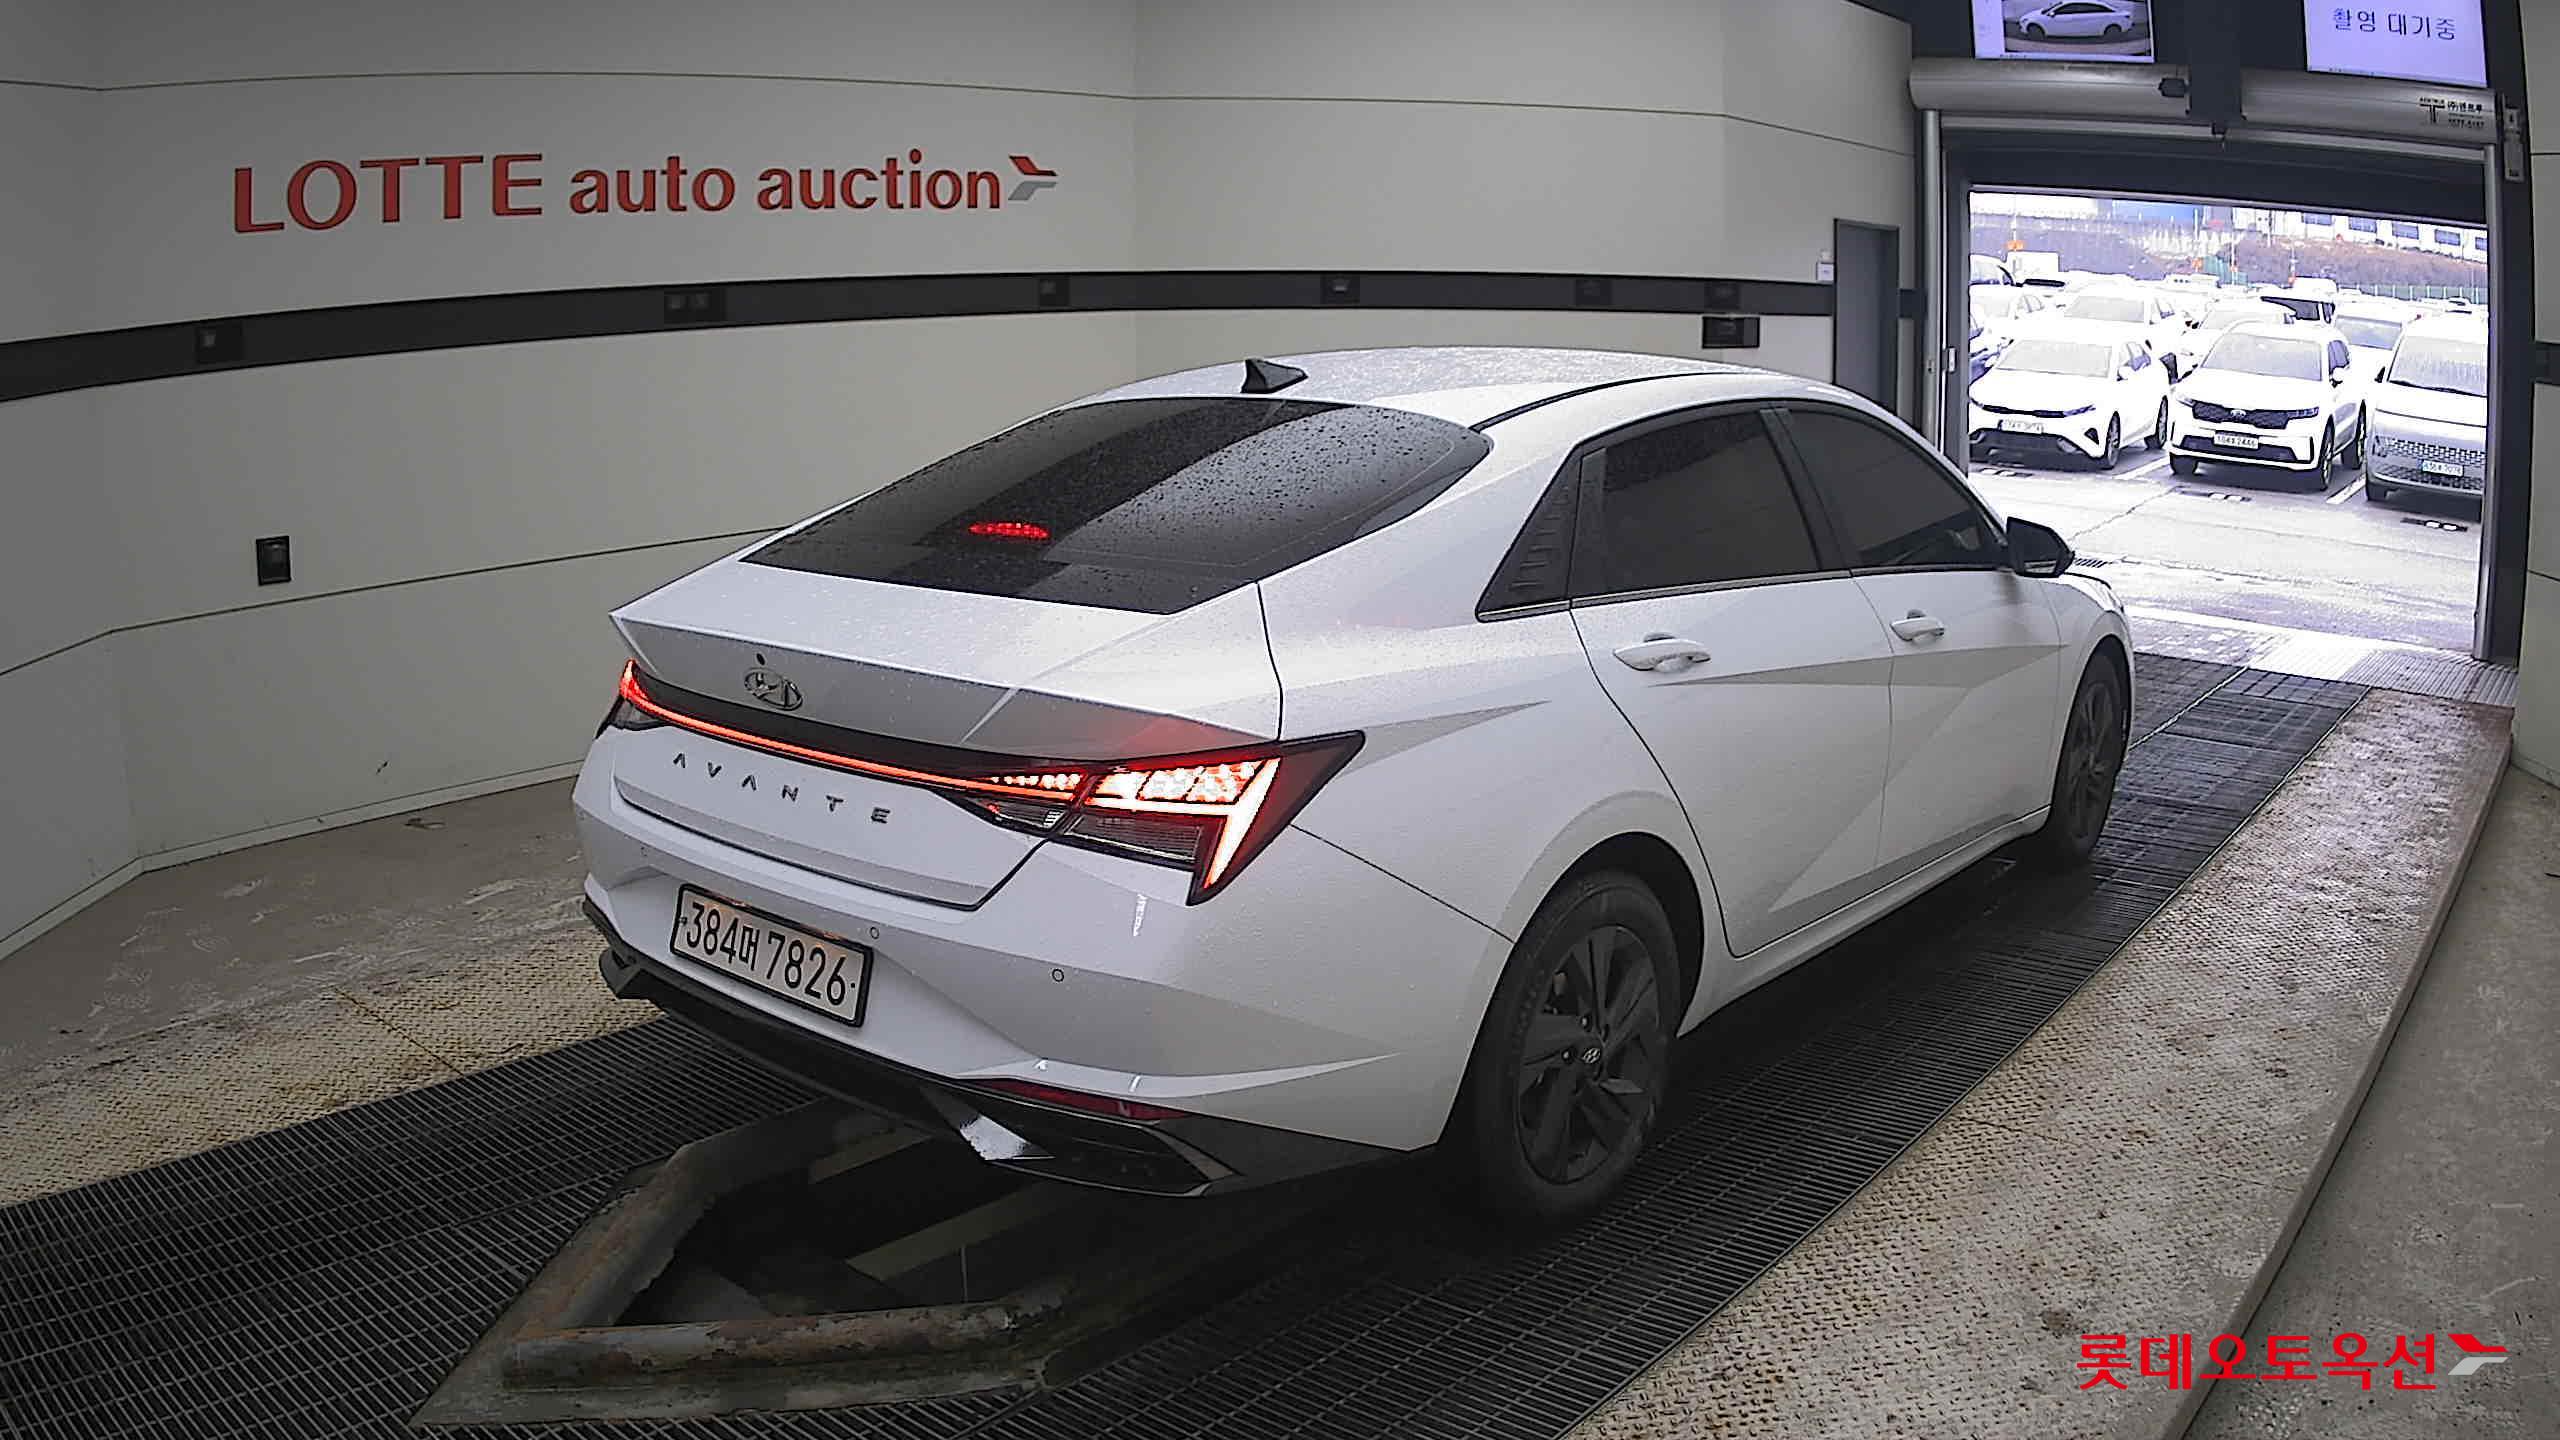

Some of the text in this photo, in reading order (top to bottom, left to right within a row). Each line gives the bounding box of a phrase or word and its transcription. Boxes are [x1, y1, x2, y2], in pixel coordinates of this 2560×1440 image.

[2333, 7, 2455, 40] 촬영 대기중
[235, 148, 1003, 233] LOTTE auto auction
[672, 752, 892, 824] AVANTE
